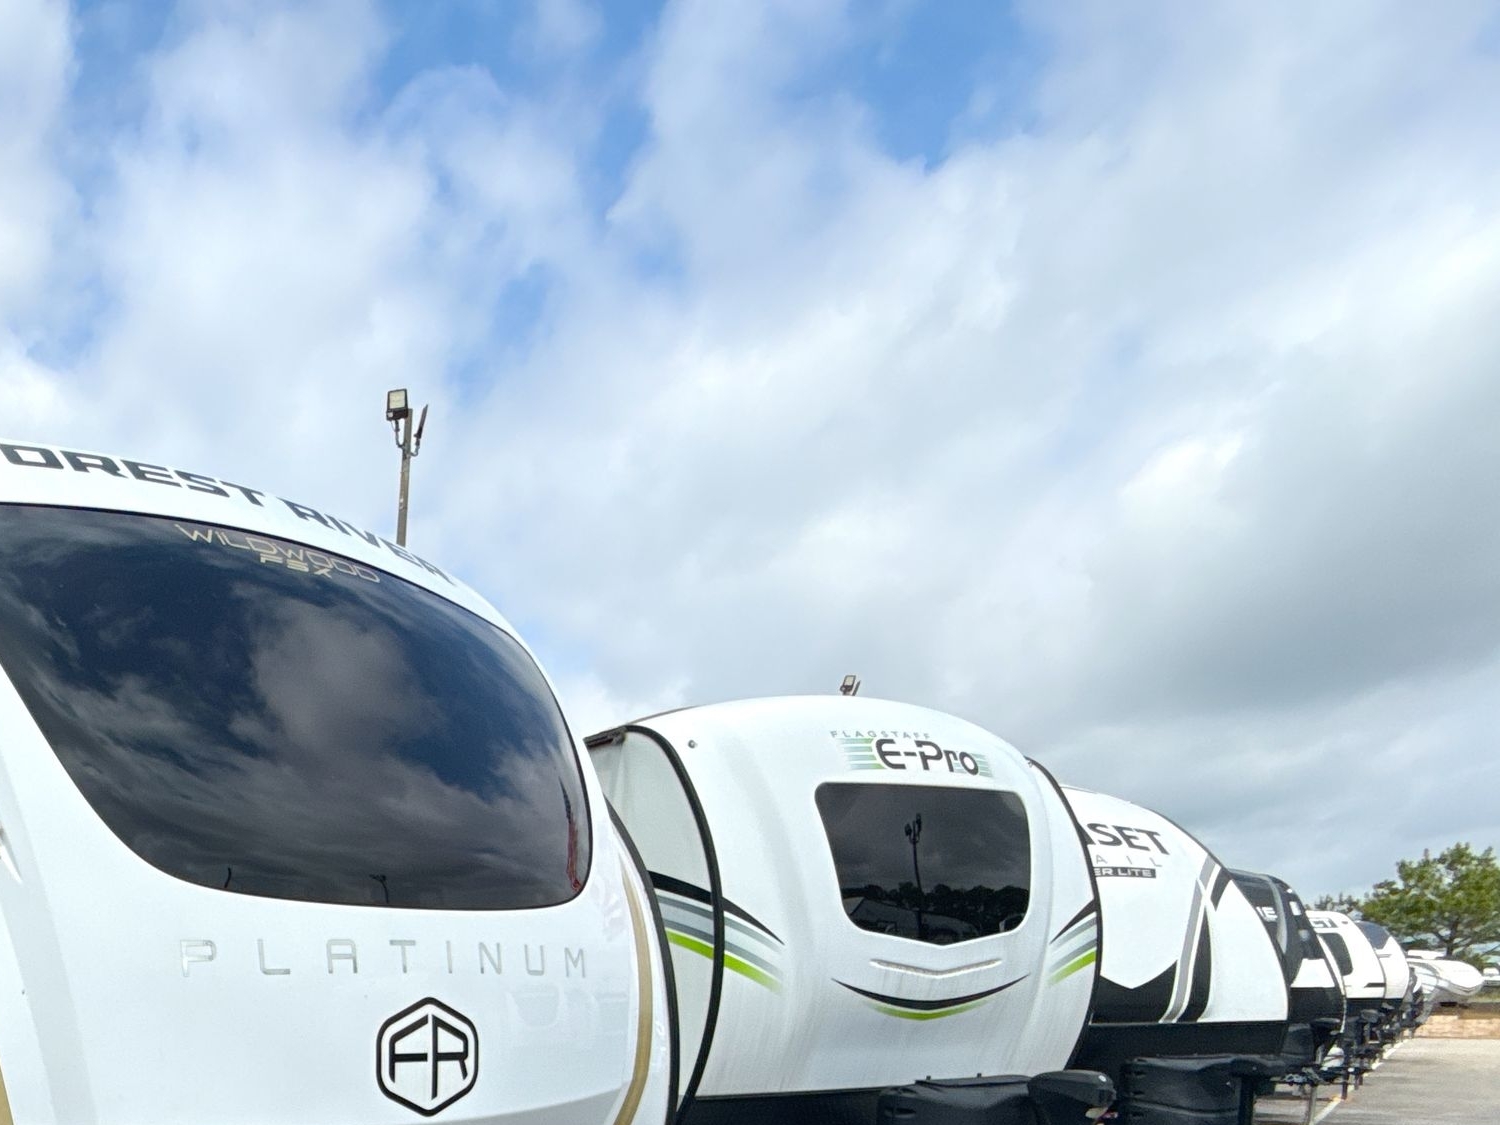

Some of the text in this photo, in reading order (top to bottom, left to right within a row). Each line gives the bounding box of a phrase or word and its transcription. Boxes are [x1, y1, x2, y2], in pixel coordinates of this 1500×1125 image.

[174, 523, 381, 584] WILDWOOD
[277, 496, 457, 586] RIVER
[259, 553, 333, 579] FSX
[830, 729, 930, 740] FLAGSTAFF
[875, 738, 980, 776] E-Pro
[1080, 822, 1171, 856] SET
[1117, 868, 1153, 878] LITE
[180, 938, 587, 979] PLATINUM
